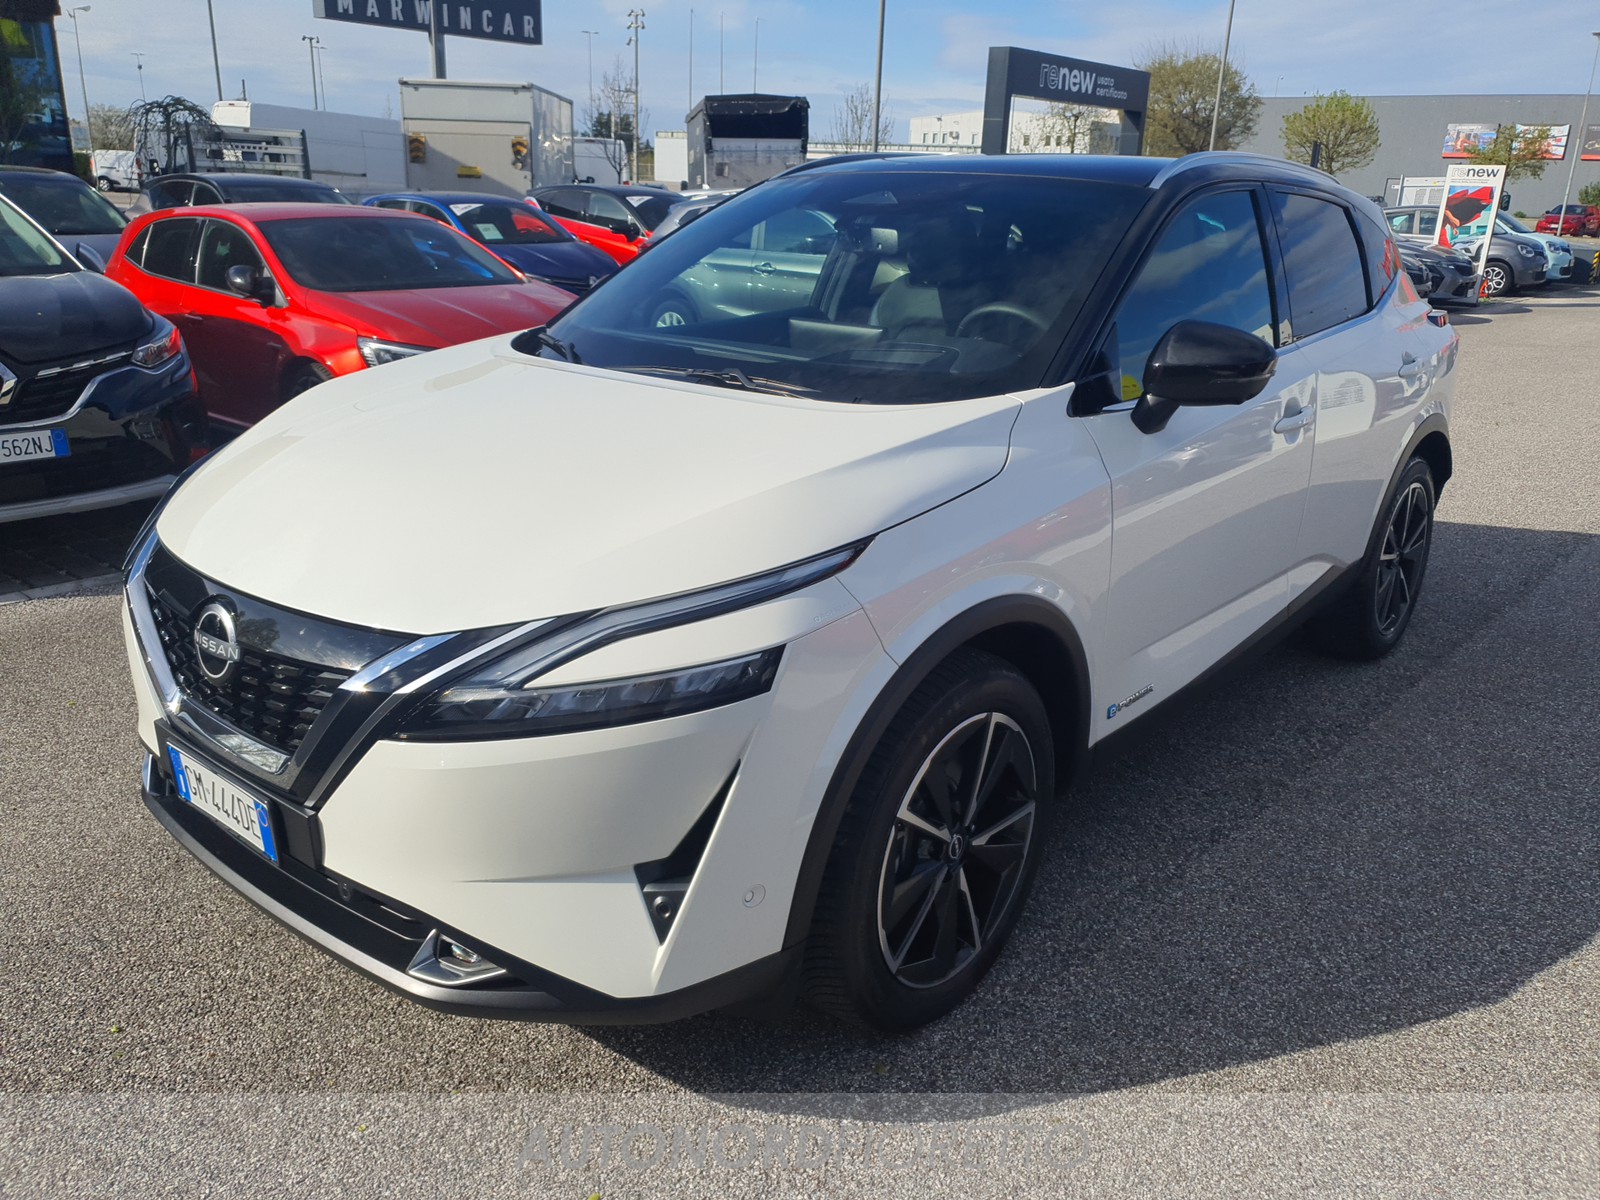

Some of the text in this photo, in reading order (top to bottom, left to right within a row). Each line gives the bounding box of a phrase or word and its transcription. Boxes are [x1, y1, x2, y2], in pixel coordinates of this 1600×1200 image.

[337, 0, 535, 38] MARWINCAR
[1040, 63, 1096, 94] renew
[1097, 76, 1115, 87] usato
[1452, 167, 1500, 178] renew
[1, 435, 54, 458] 562NJ
[195, 630, 239, 660] NISSAN
